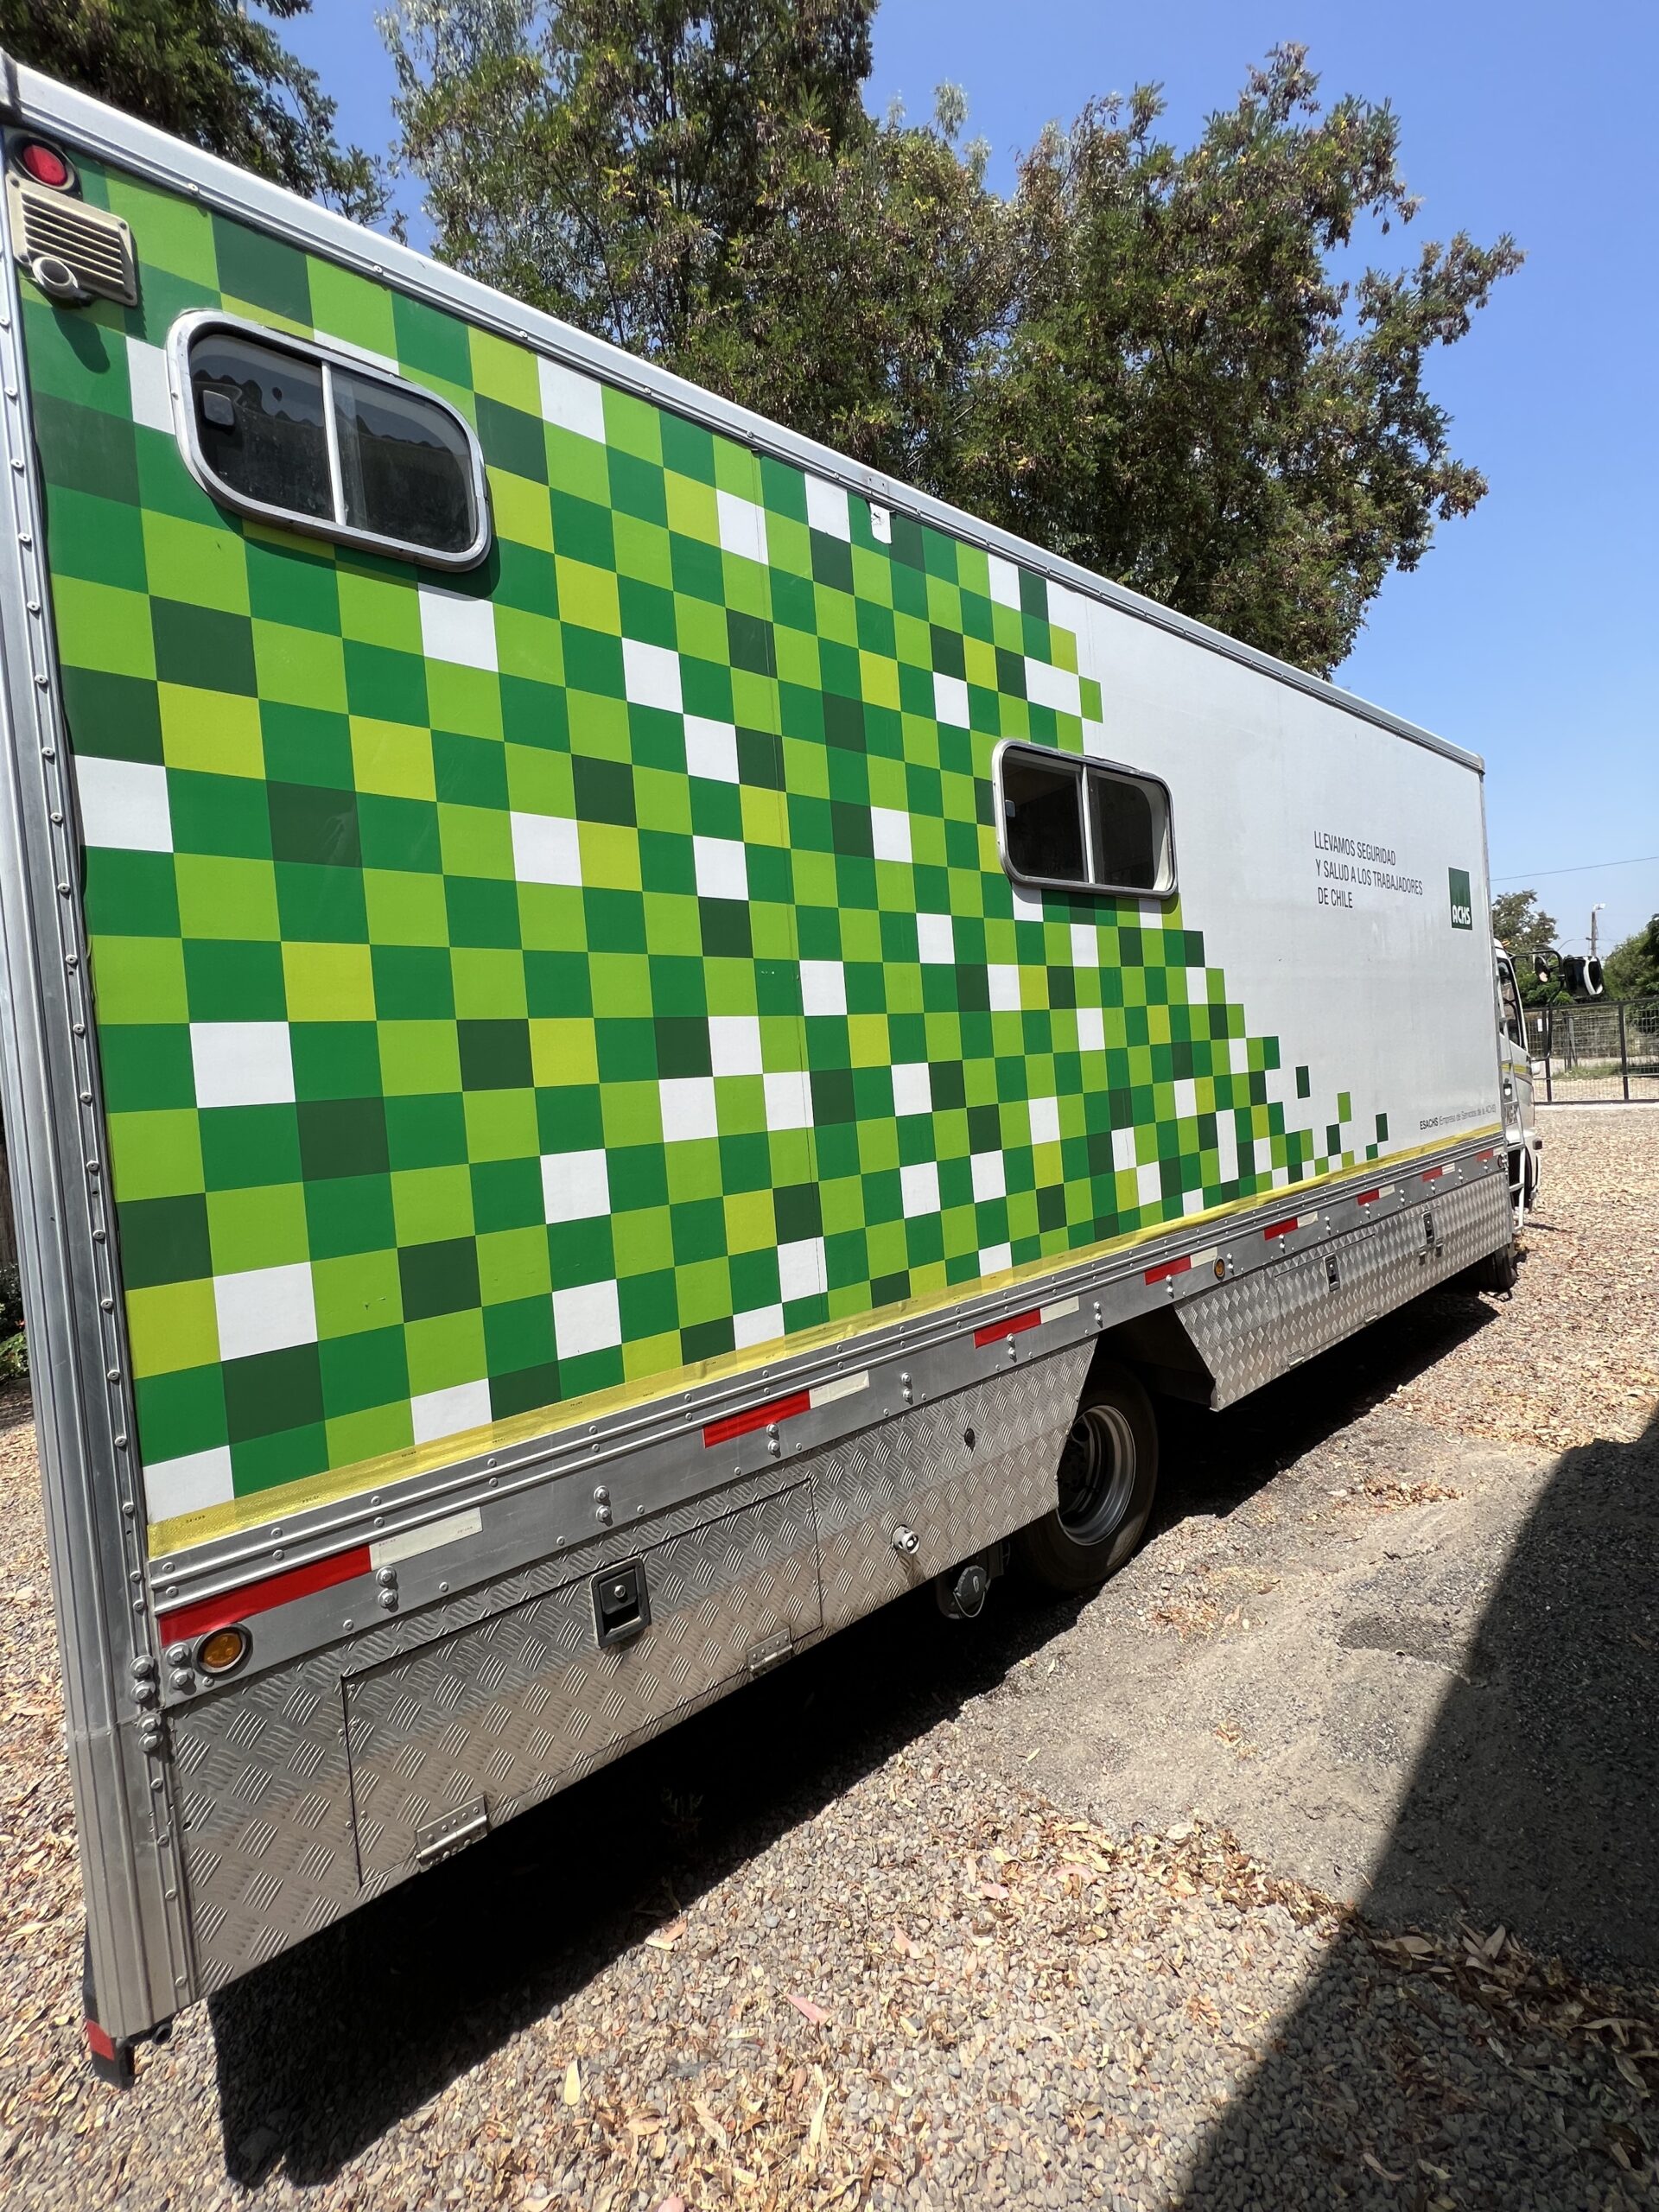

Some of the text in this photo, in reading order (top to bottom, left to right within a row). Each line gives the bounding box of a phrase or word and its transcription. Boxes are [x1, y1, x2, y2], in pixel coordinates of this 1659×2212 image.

[1313, 830, 1396, 867] LLEVAMOS SEGURIDAD
[1315, 858, 1423, 896] Y SALUD A LOS TRABAJADORES
[1318, 887, 1354, 909] DE CHILE
[1452, 904, 1471, 925] ACHS
[1420, 1117, 1439, 1130] ESACHS
